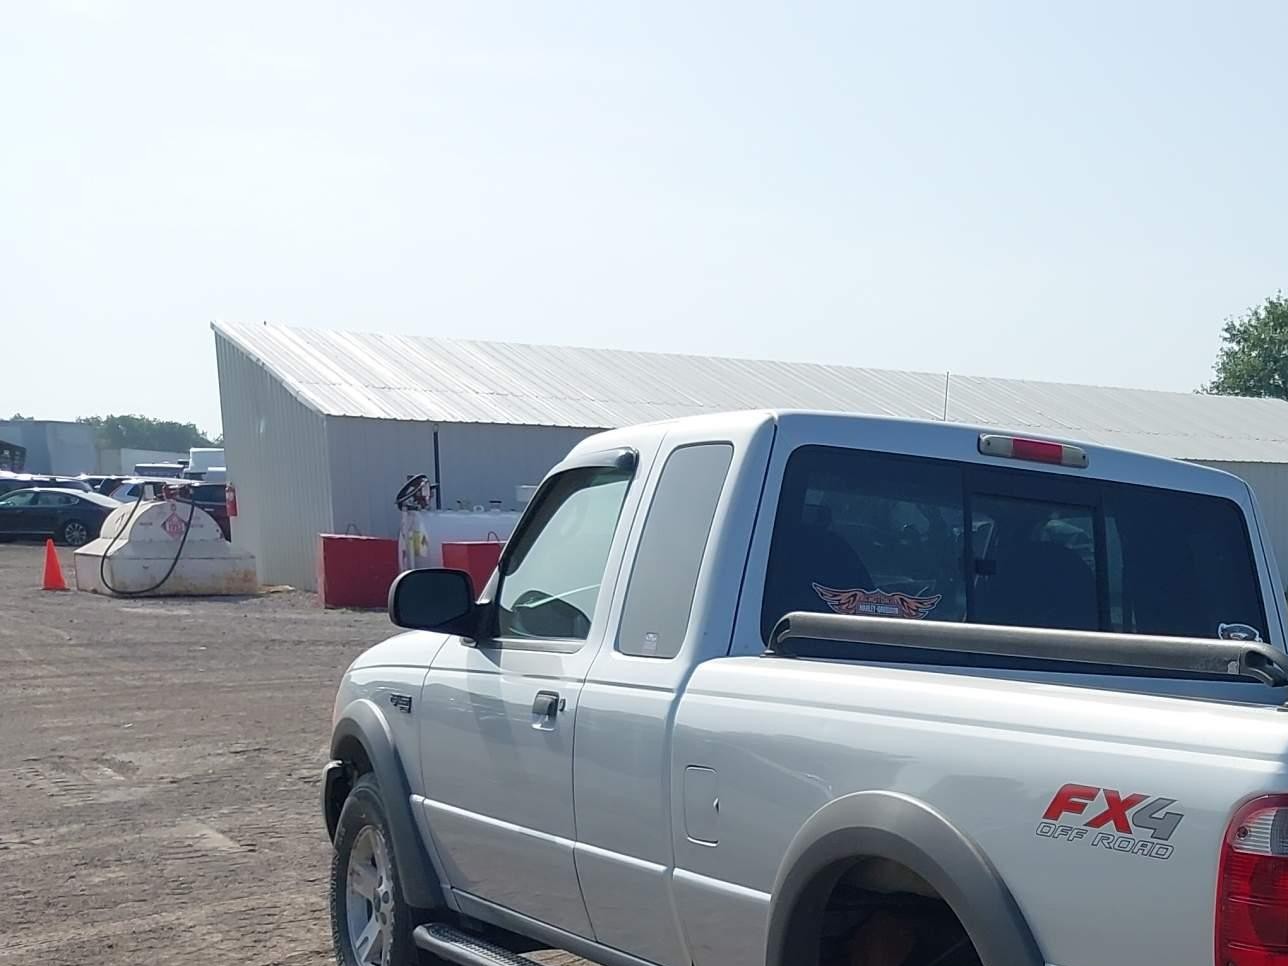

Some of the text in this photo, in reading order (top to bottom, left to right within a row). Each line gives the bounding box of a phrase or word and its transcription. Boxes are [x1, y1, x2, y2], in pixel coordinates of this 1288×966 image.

[1042, 783, 1184, 841] FX4
[1035, 821, 1175, 860] OFF ROAD
